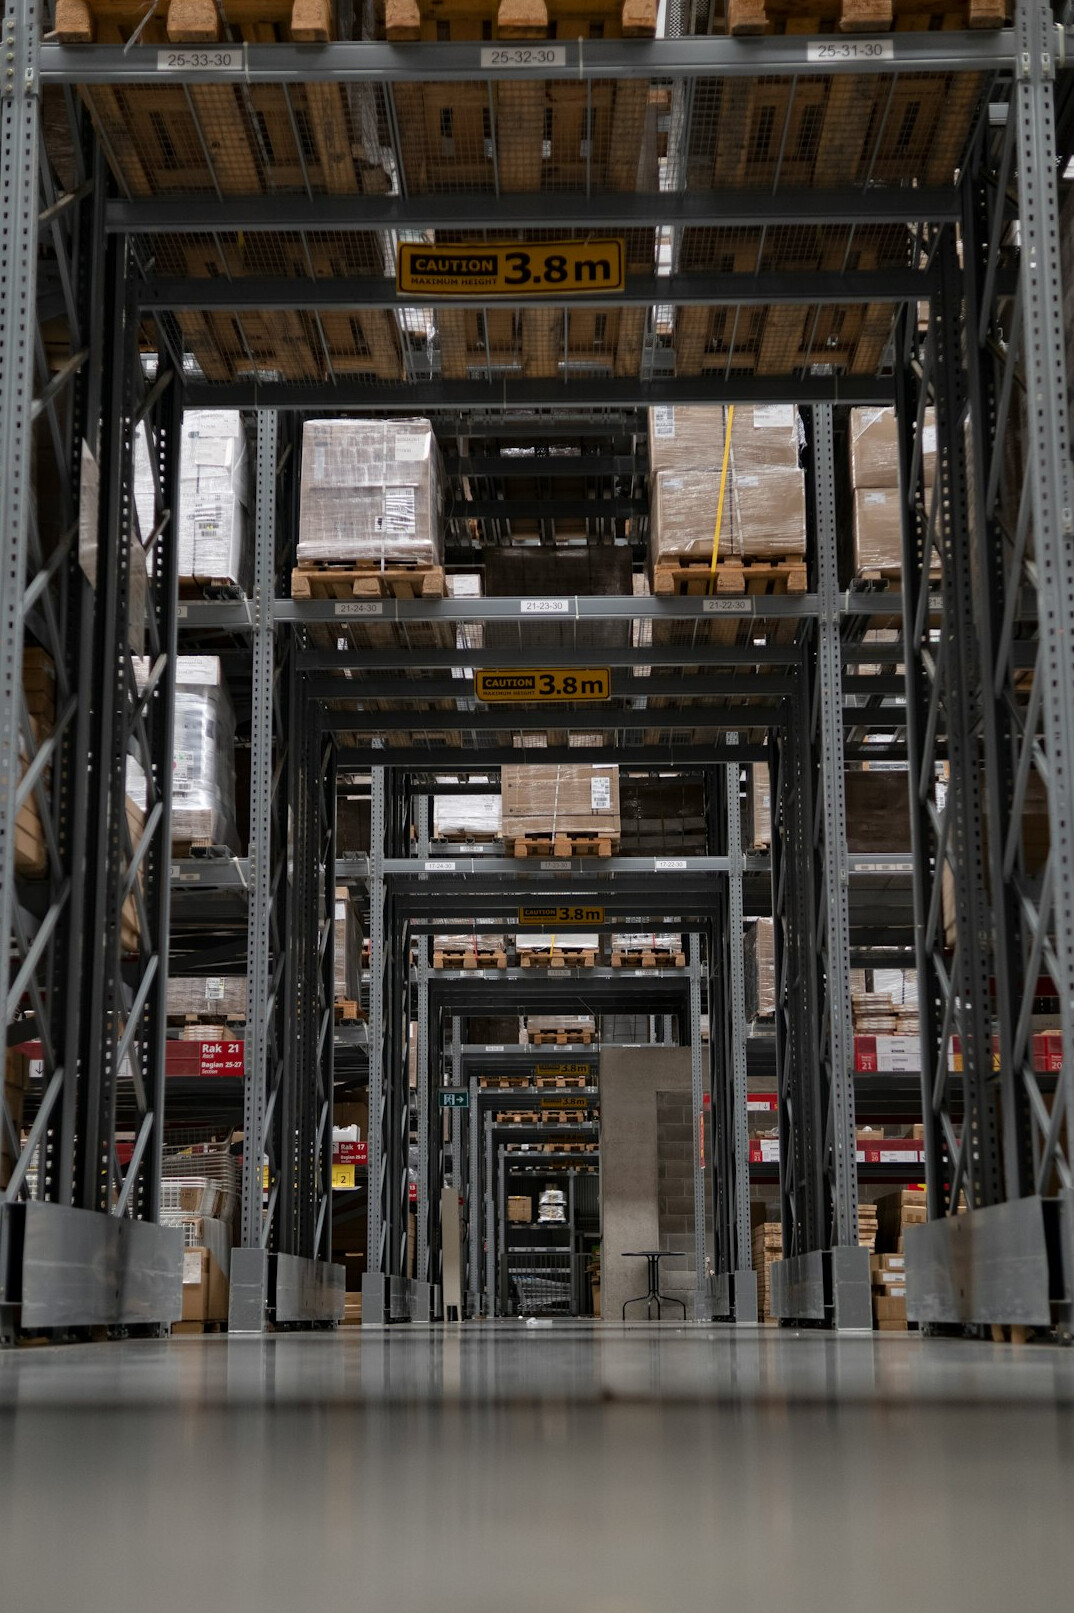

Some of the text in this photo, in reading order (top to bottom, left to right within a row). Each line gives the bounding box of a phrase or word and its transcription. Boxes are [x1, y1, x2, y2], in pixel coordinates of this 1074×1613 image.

[817, 43, 883, 58] 25-31-30
[167, 53, 232, 67] 25-33-30
[490, 50, 555, 65] 25-32-30
[415, 258, 493, 273] CAUTION
[411, 276, 497, 286] MAXIMUM HEIGHT
[340, 604, 377, 613] 21-24-30
[526, 601, 563, 611] 21-23-30
[709, 601, 746, 610] 21-22-30
[485, 678, 533, 688] CAUTION
[202, 1044, 239, 1053] Rak 21
[861, 1062, 872, 1070] 21
[1051, 1062, 1062, 1070] 20
